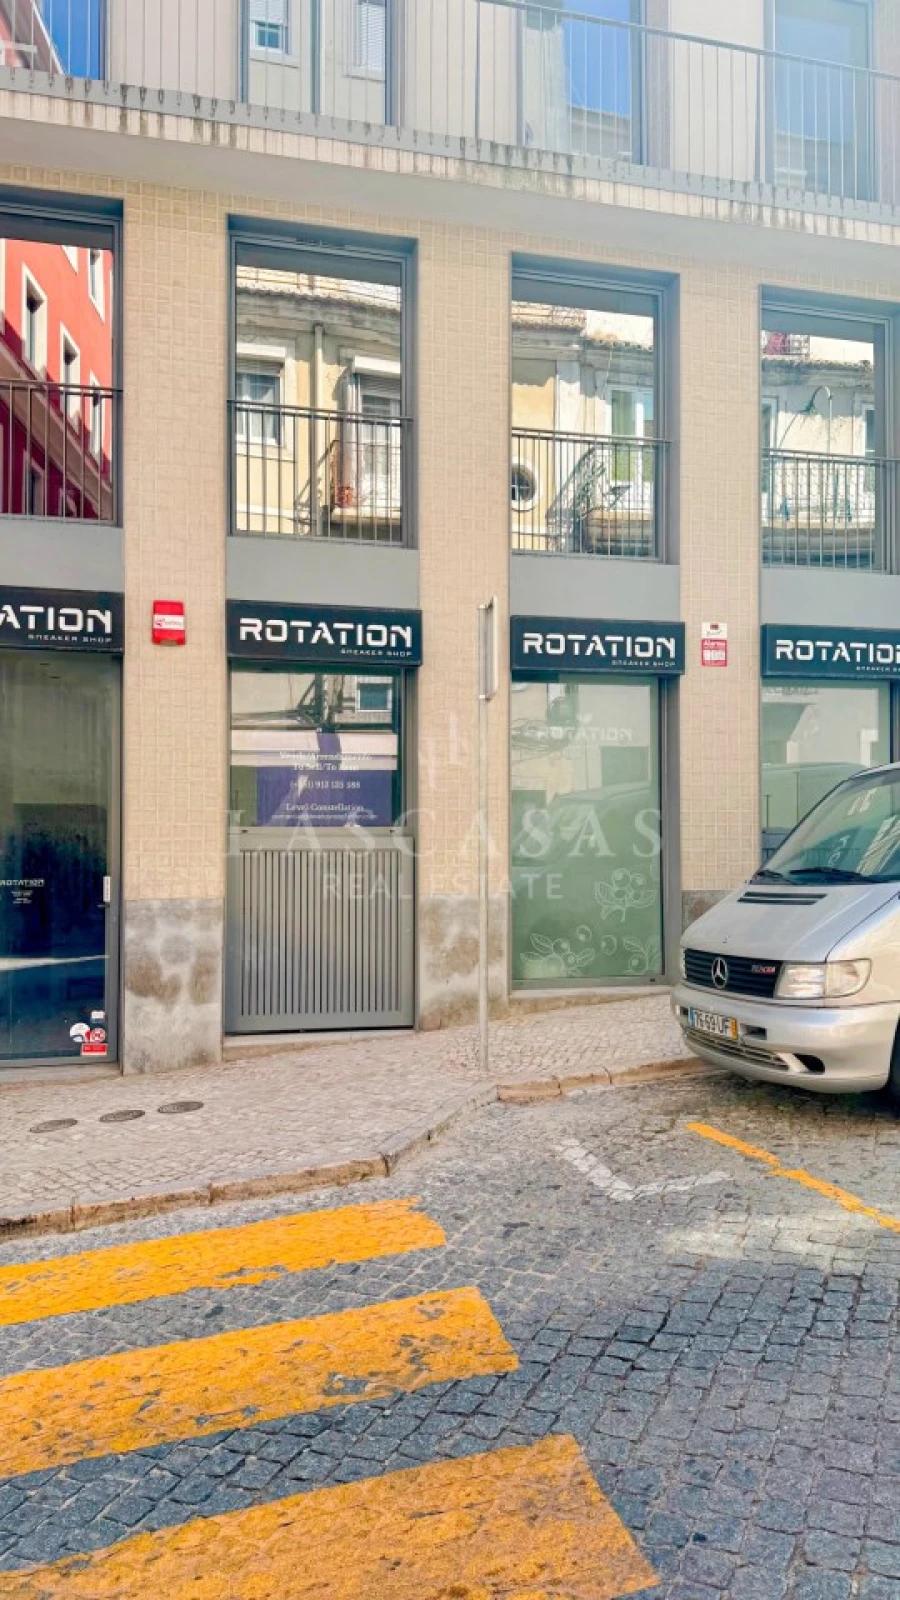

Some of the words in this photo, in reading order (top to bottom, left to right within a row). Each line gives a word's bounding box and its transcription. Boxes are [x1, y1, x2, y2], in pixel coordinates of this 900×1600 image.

[28, 634, 78, 642] SNEAKER
[239, 618, 412, 647] ROTATION
[523, 633, 676, 658] ROTATION
